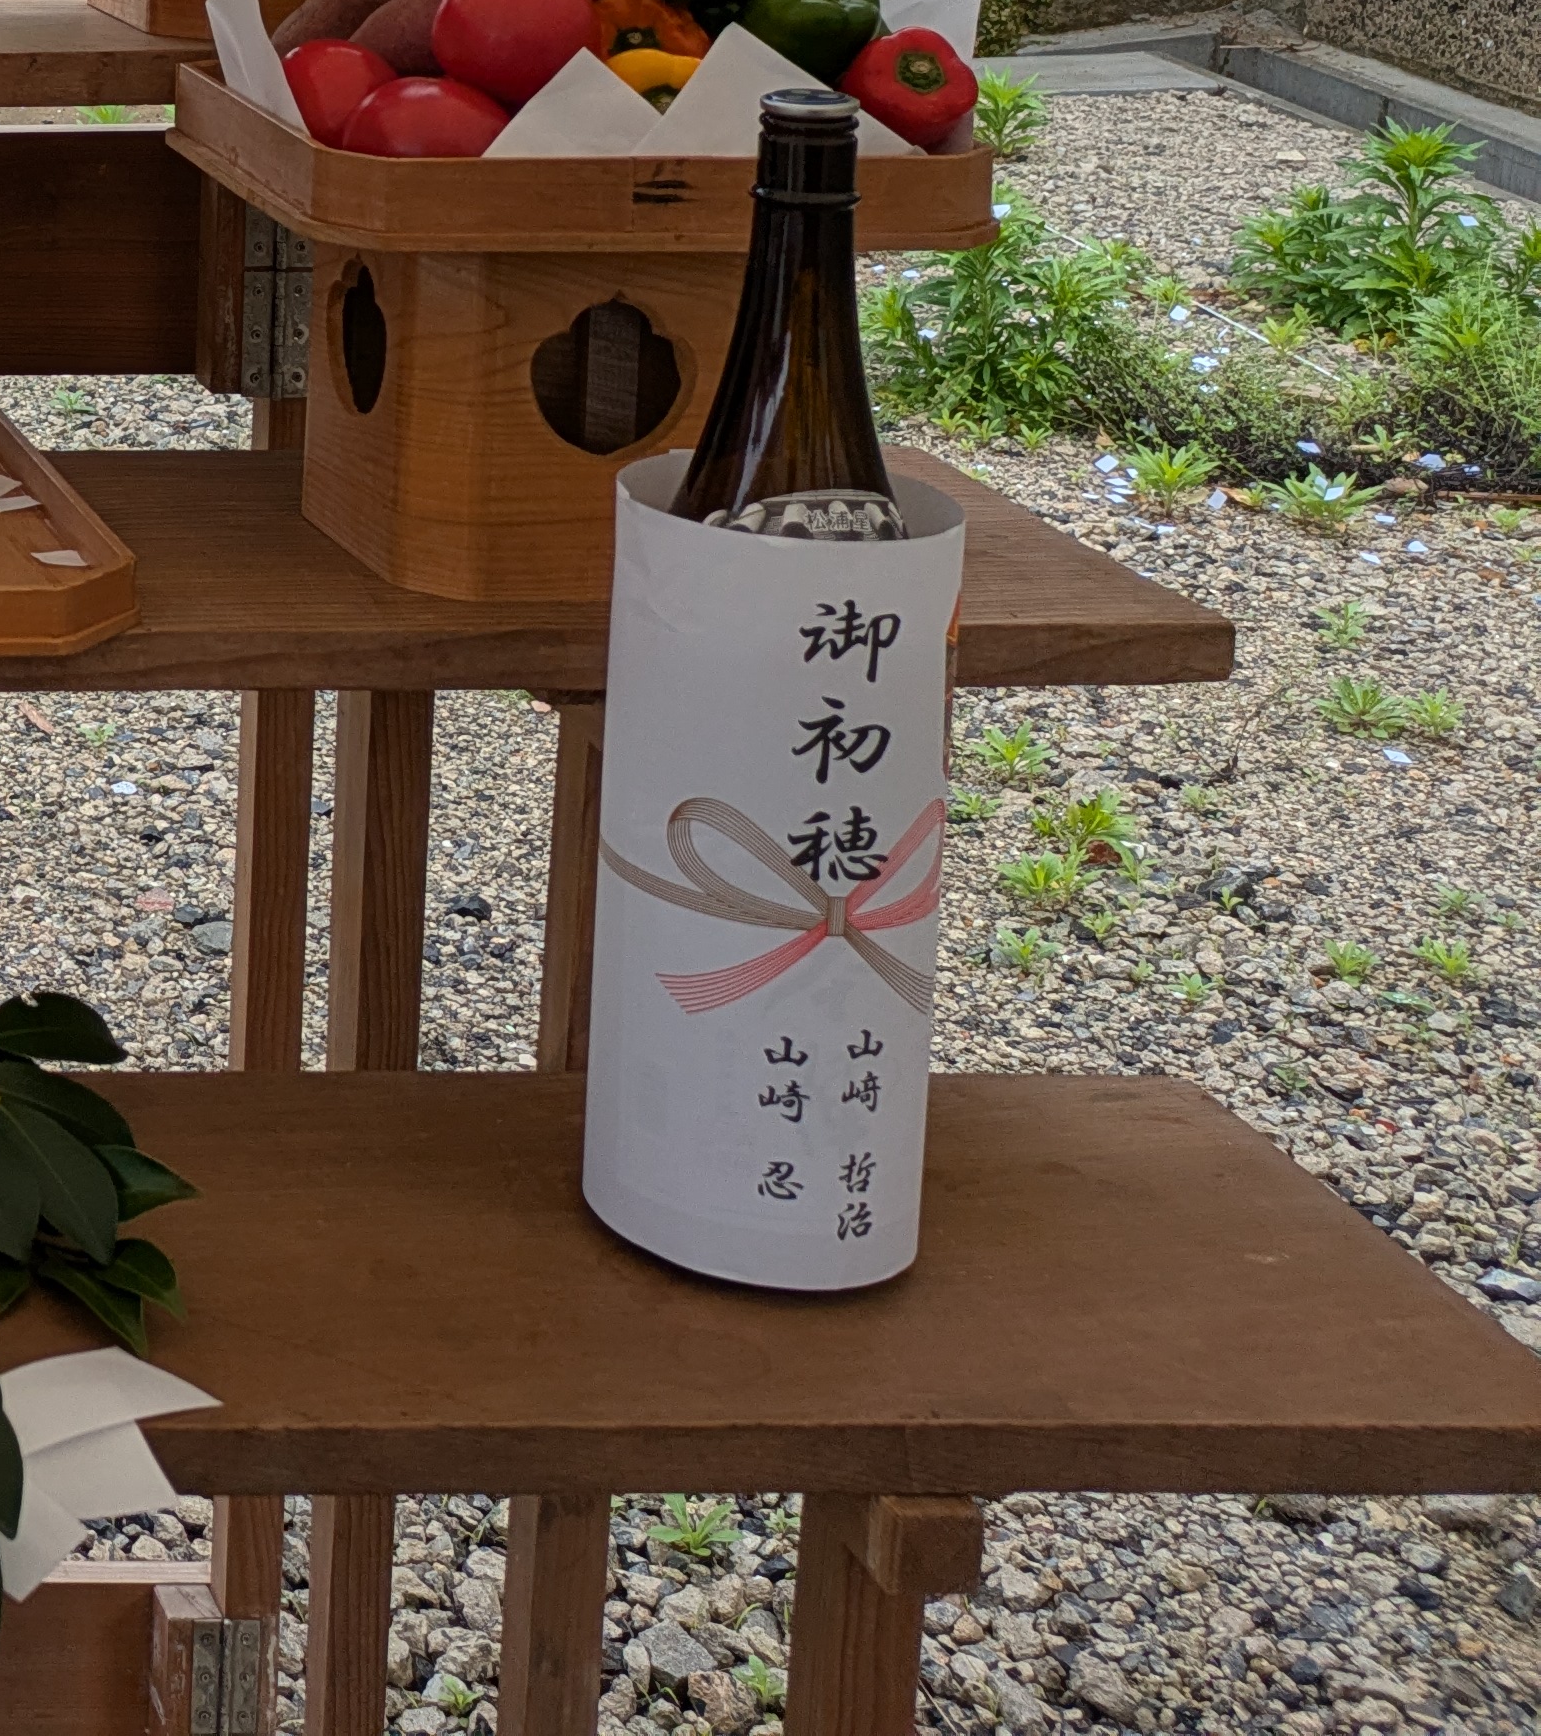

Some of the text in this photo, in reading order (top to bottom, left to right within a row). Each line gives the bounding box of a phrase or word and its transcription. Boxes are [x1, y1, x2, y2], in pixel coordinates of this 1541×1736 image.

[787, 599, 901, 881] 御初穂
[758, 1161, 804, 1200] 忍
[837, 1152, 877, 1241] 哲治
